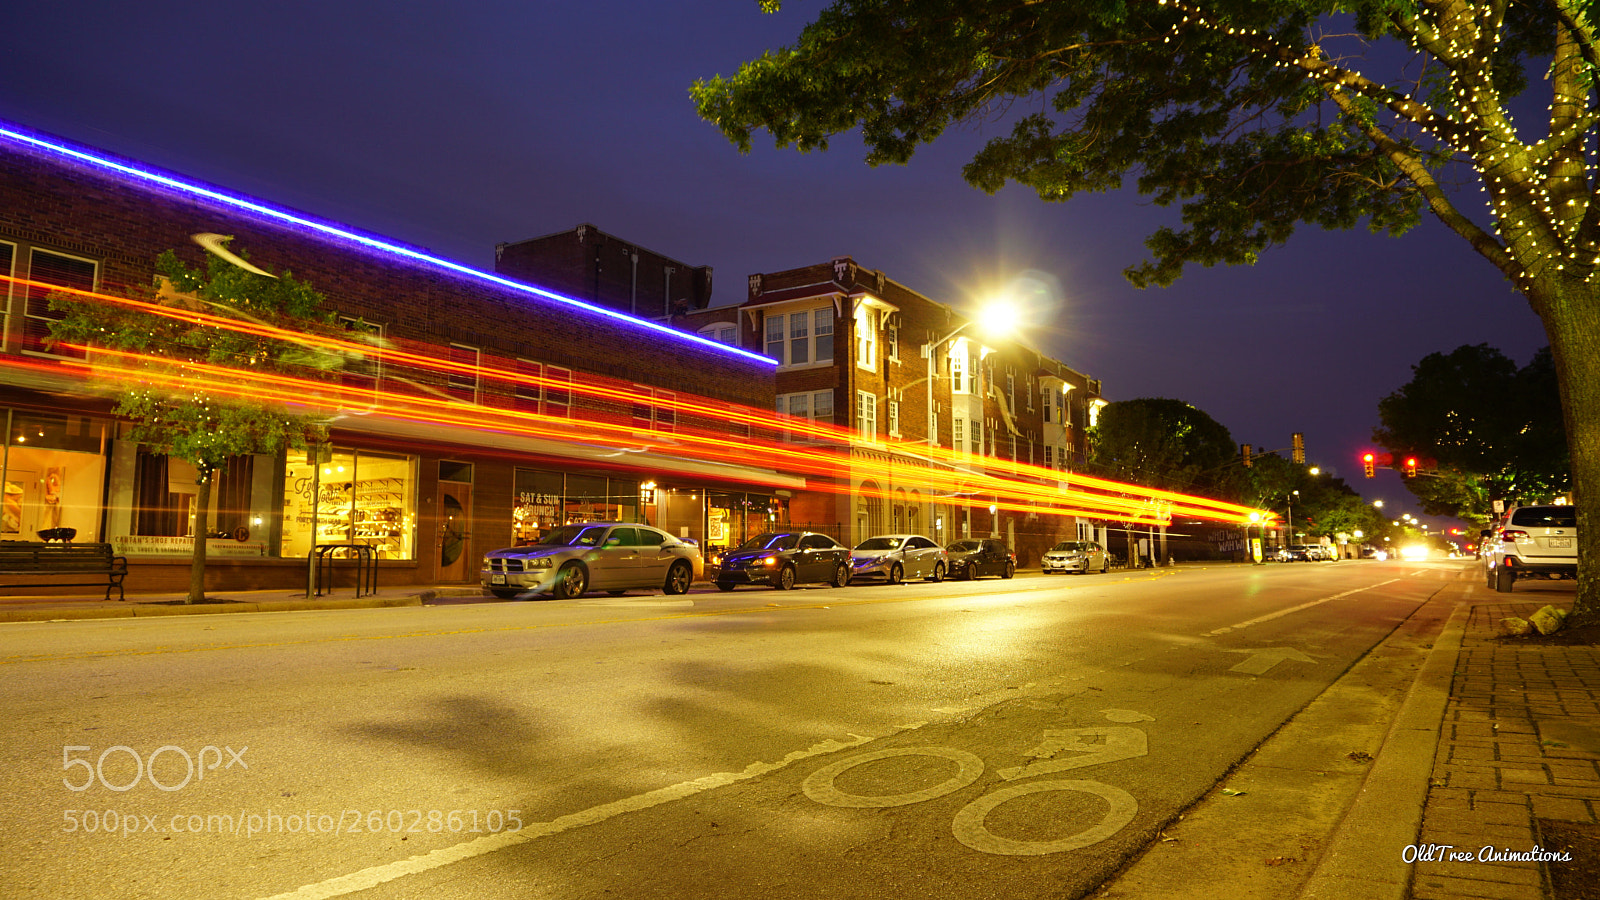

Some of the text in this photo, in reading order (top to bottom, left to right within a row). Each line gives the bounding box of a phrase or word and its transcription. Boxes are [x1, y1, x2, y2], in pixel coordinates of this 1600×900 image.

[520, 491, 559, 505] SAT & SUN
[523, 504, 555, 517] BRUNCH
